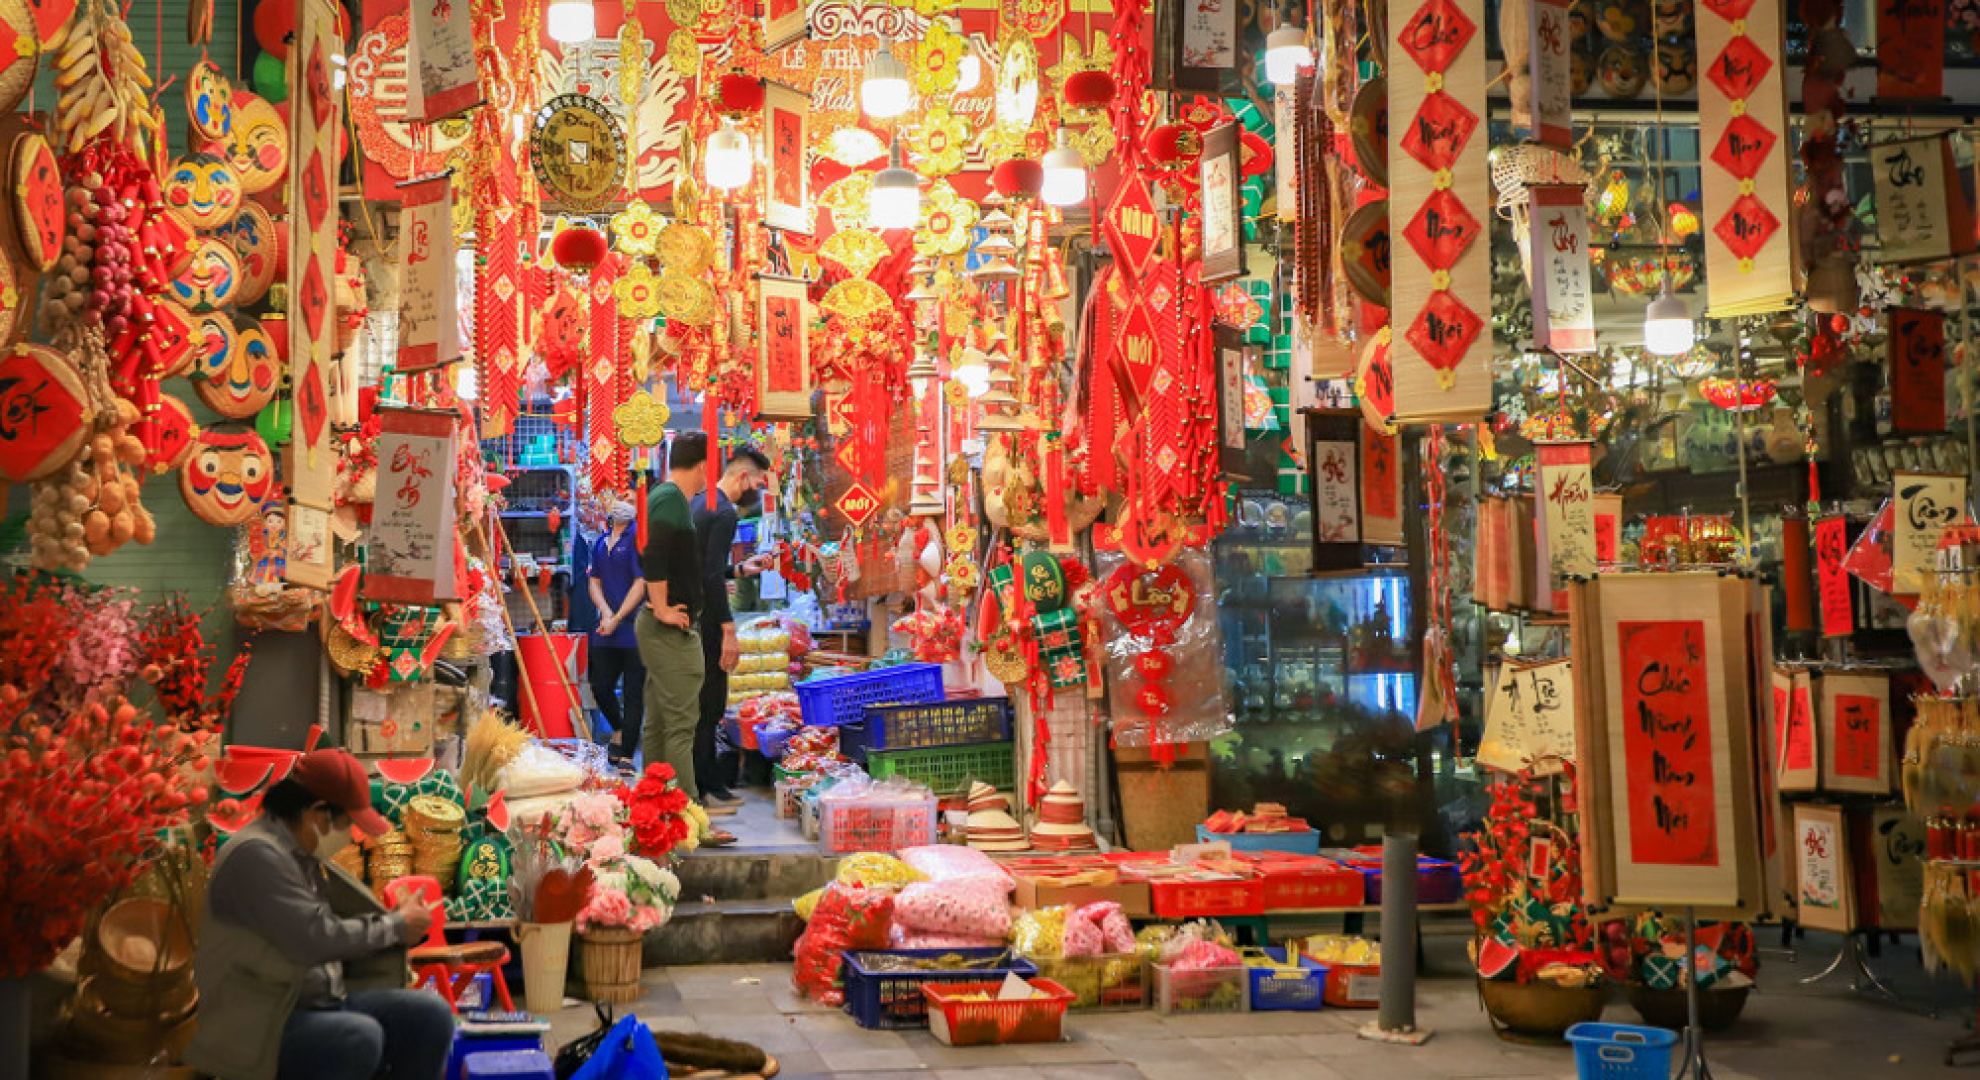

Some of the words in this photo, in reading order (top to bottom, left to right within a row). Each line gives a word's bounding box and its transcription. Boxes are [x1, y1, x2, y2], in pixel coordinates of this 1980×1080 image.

[1122, 204, 1154, 239] NĂM
[1127, 333, 1153, 367] MỚI
[844, 495, 871, 511] MỚI
[1639, 660, 1691, 696] Chúc
